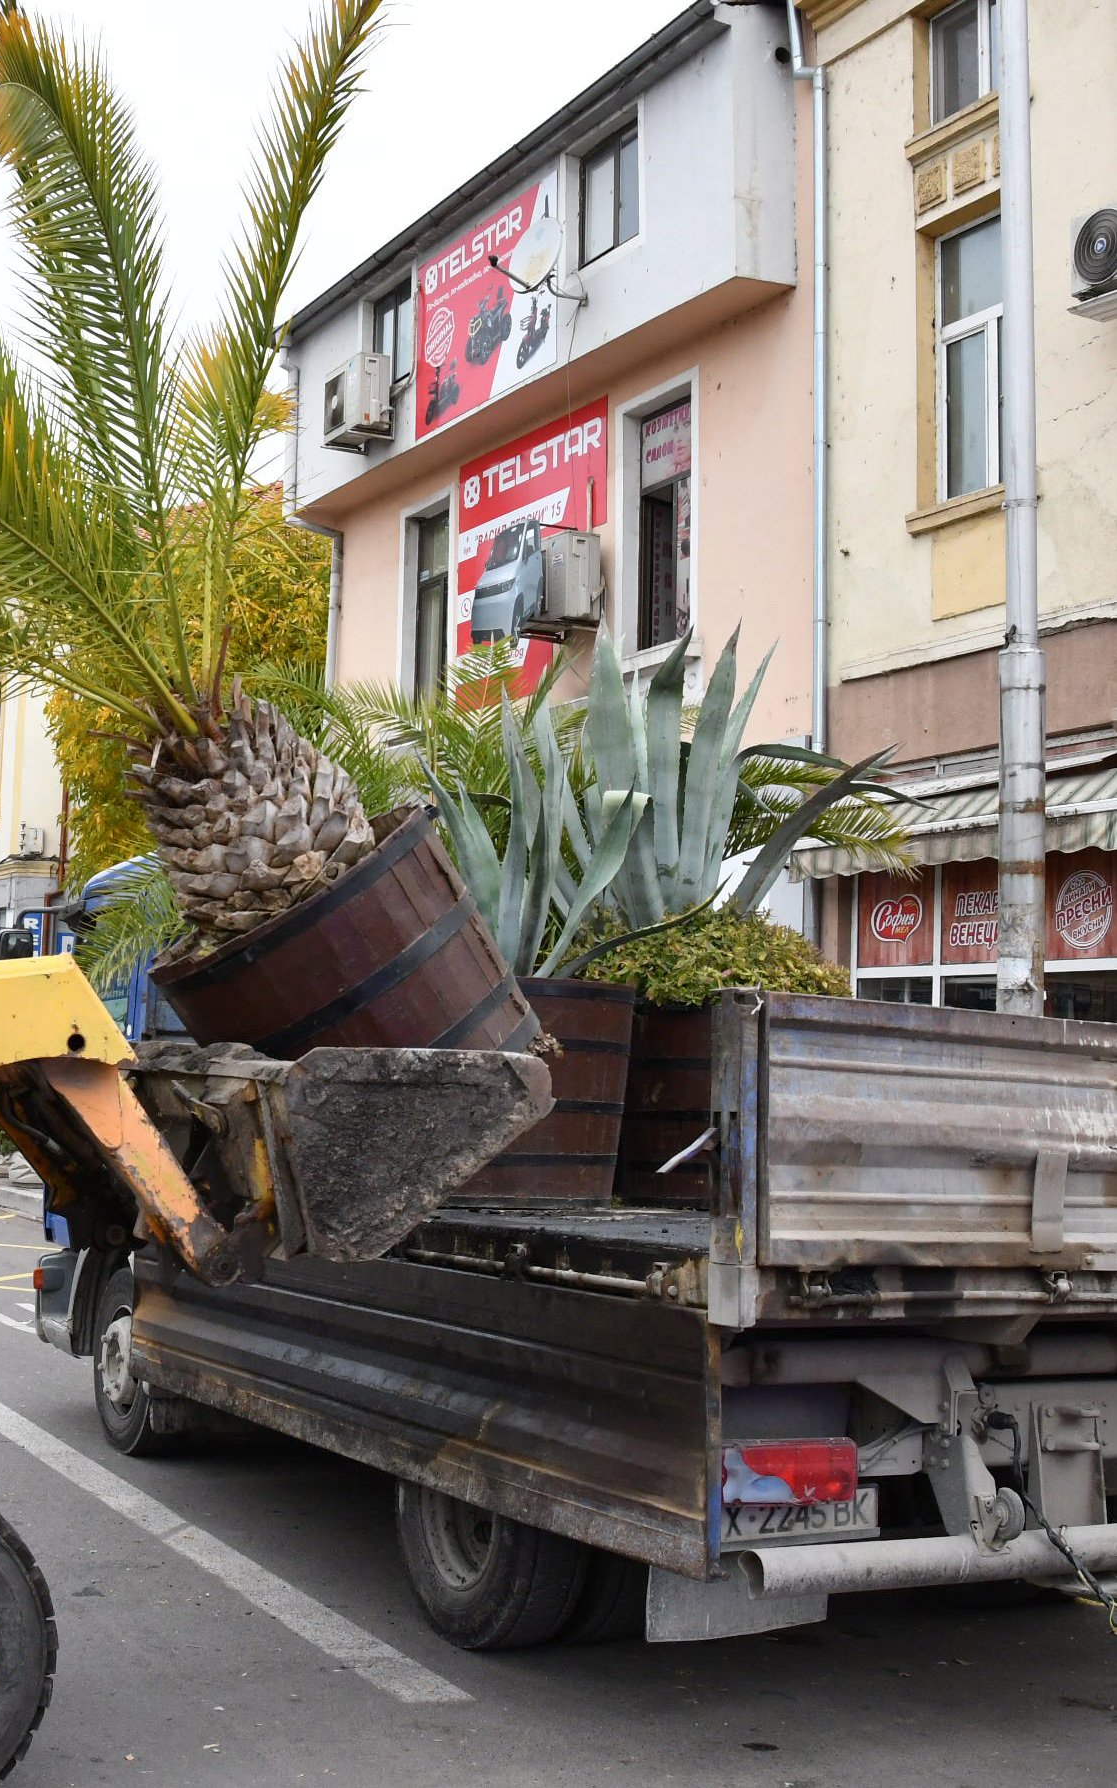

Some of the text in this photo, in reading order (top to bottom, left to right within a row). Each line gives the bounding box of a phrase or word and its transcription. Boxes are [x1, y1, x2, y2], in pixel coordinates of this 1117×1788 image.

[438, 205, 523, 284] TELSTAR
[426, 320, 453, 354] ORIGINAL
[482, 416, 602, 498] TELSTAR
[1056, 886, 1113, 932] ПРЕСНИ
[1064, 881, 1096, 906] ВИНАГИ
[876, 904, 914, 936] София
[1072, 914, 1105, 940] ВКУСНИ
[758, 1504, 826, 1535] 2245
